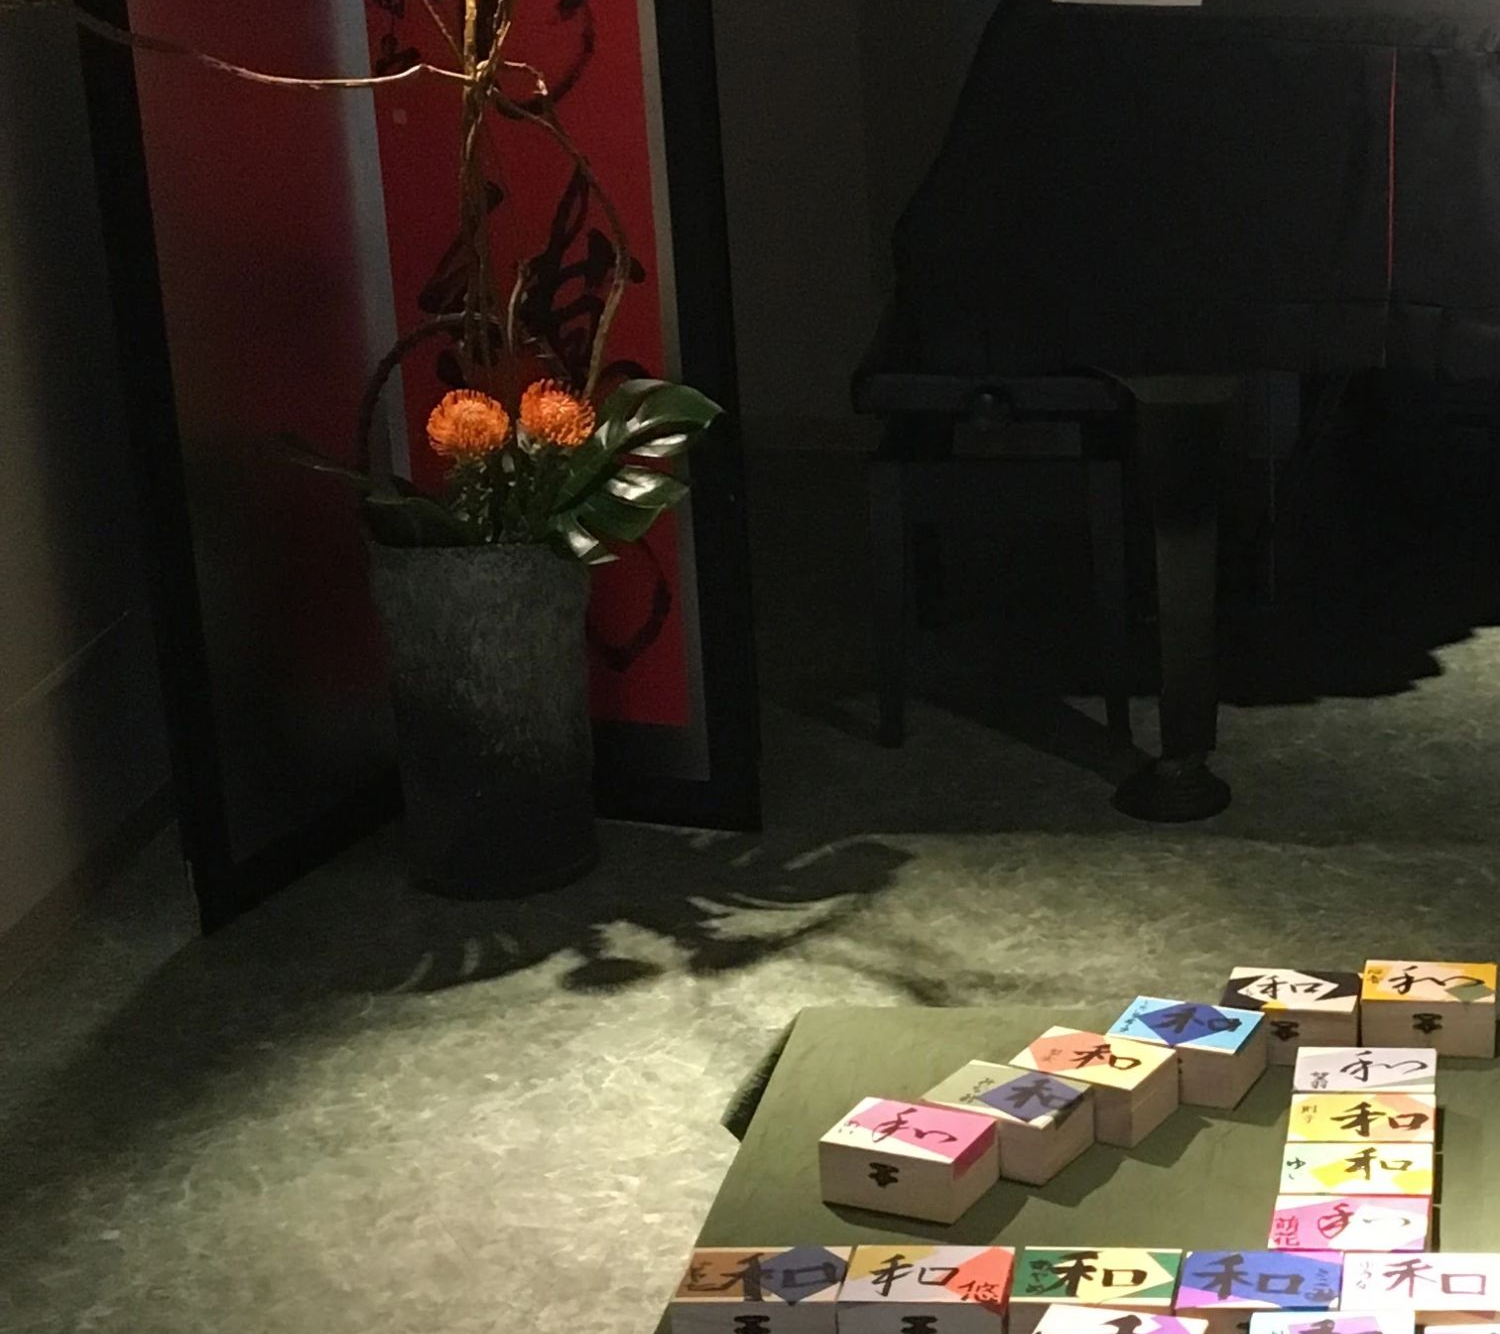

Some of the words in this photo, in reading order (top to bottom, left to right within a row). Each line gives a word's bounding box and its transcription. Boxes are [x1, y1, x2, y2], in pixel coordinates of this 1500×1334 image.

[1257, 975, 1324, 999] 和
[1071, 1044, 1142, 1070] 和
[1330, 1101, 1430, 1137] 和
[1344, 1147, 1413, 1180] 和
[724, 1252, 840, 1302] 和
[870, 1254, 959, 1297] 和
[1044, 1250, 1148, 1297] 和
[1192, 1254, 1305, 1301] 和
[1382, 1259, 1487, 1298] 和
